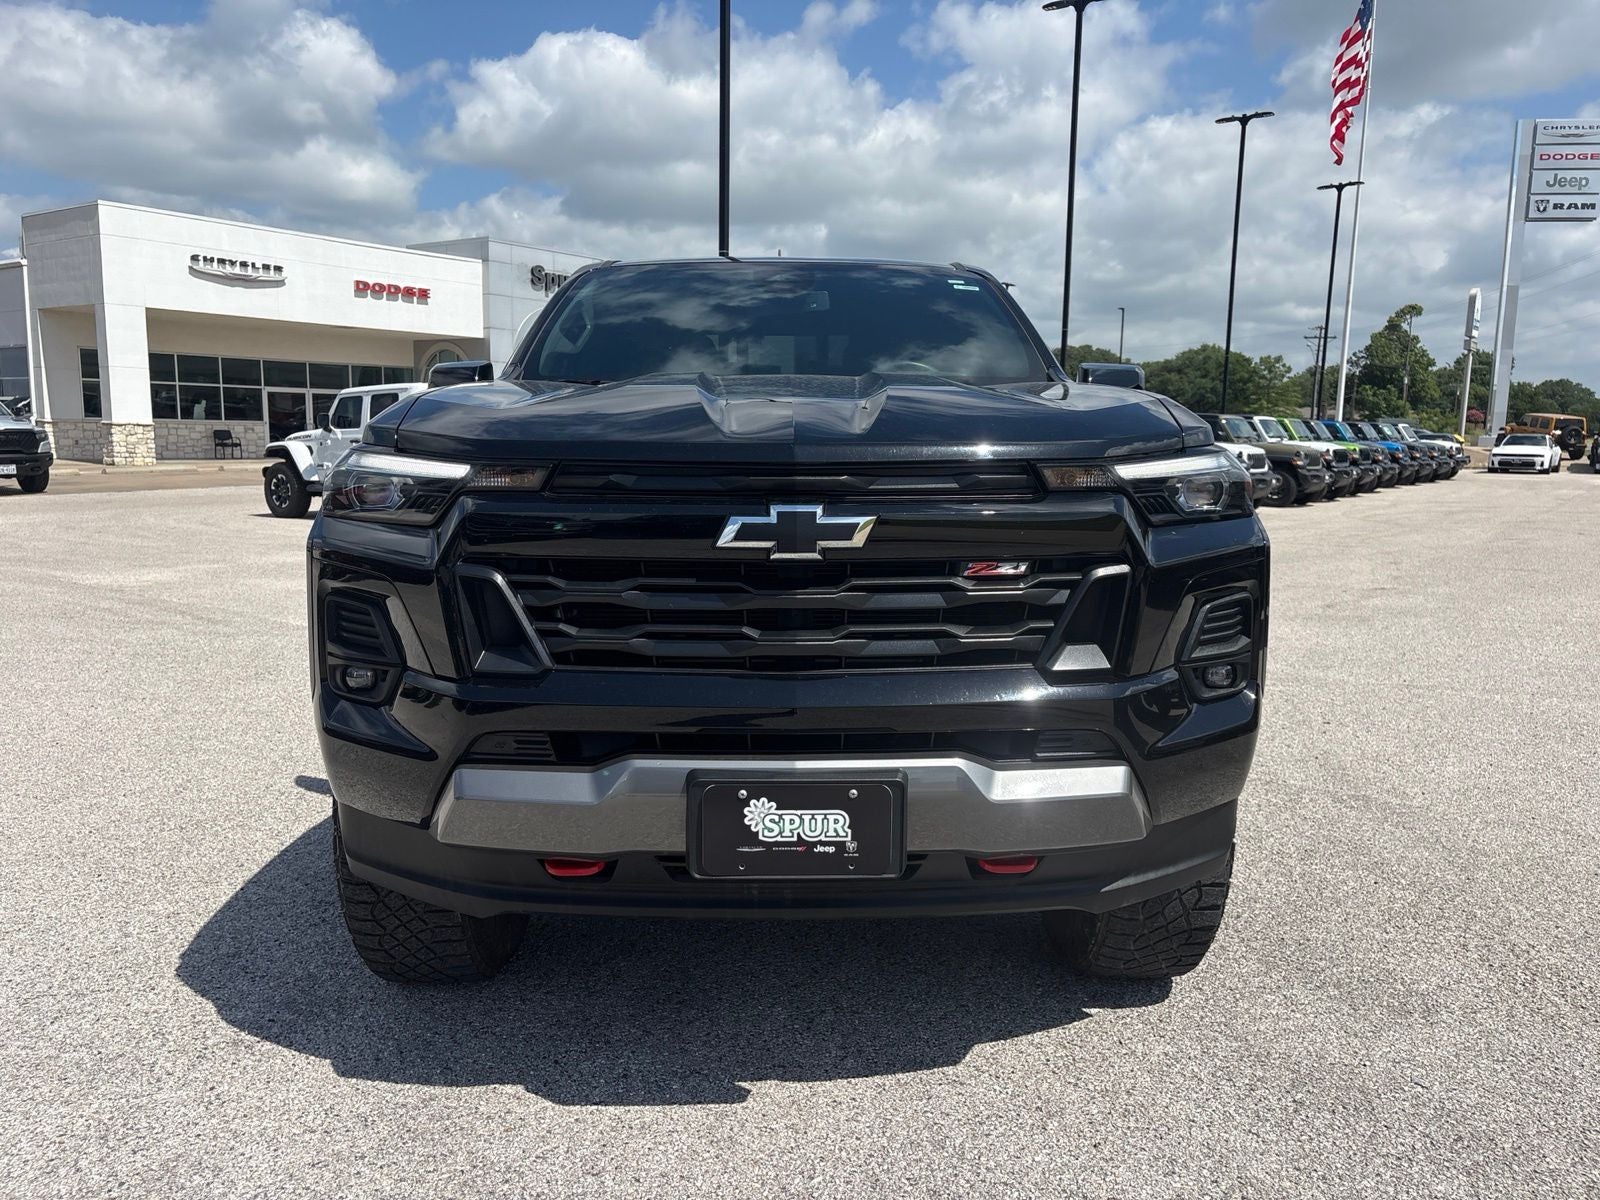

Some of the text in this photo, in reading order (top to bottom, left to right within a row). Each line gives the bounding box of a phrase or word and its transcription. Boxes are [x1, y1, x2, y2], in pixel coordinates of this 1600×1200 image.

[1540, 153, 1600, 161] DODGE
[1545, 173, 1590, 191] Jeep
[190, 254, 284, 274] CHRYSLER
[353, 279, 431, 301] DODGE
[963, 562, 1029, 576] Z71
[760, 811, 851, 840] SPUR
[813, 844, 836, 853] Jeep
